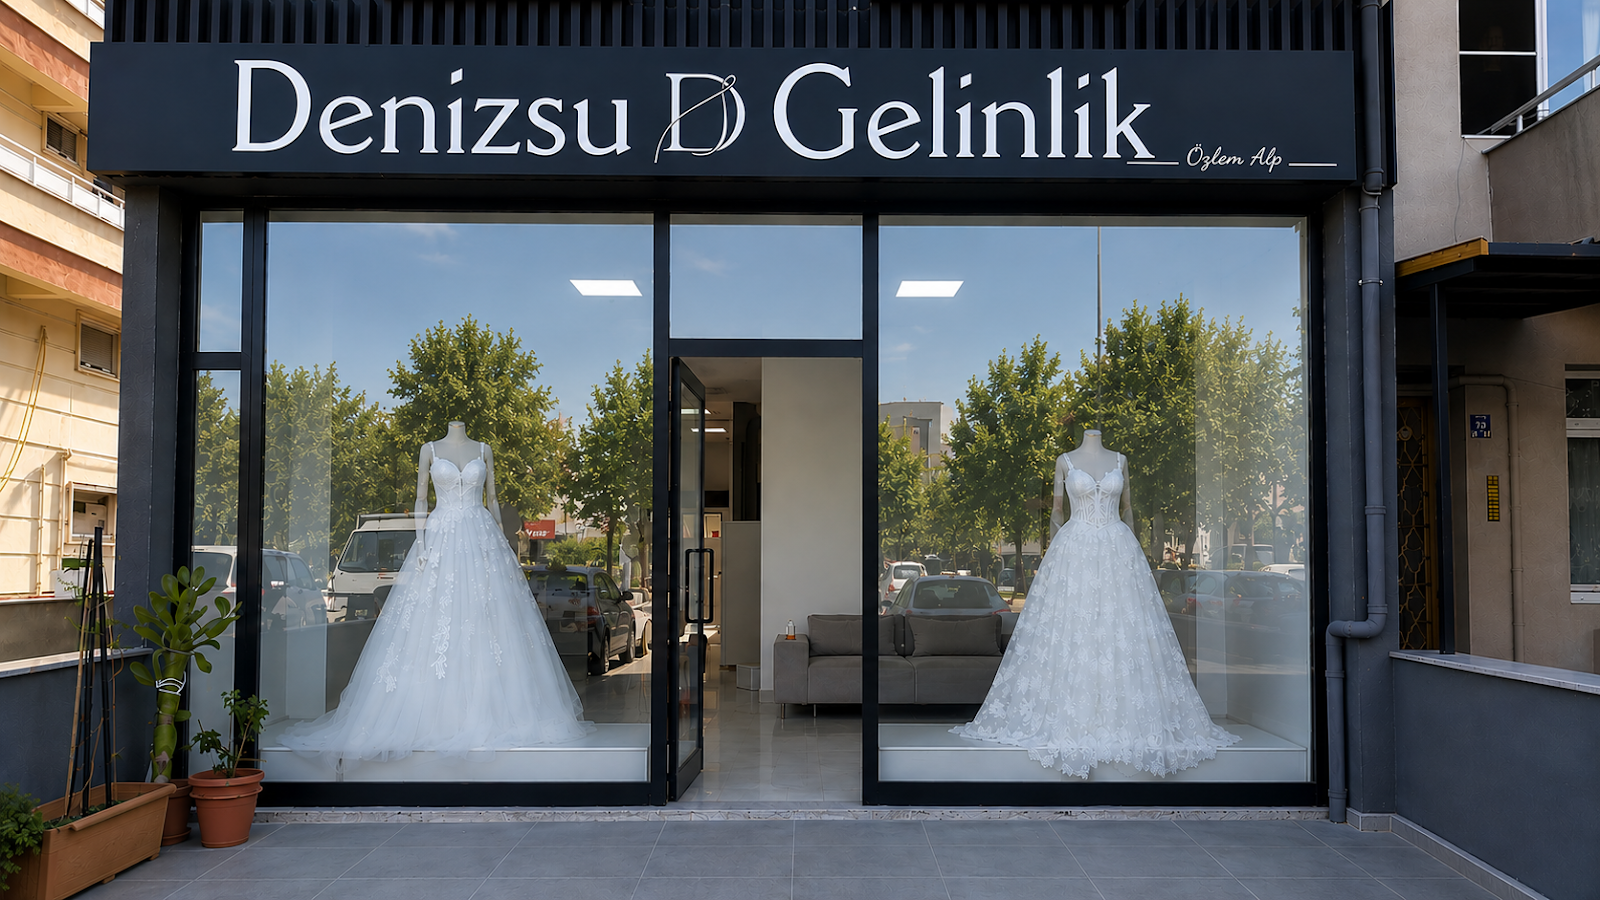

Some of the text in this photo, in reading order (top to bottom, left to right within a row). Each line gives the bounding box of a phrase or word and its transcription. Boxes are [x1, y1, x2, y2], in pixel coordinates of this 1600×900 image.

[232, 60, 632, 156] Denizsu
[773, 63, 1156, 160] Gelinlik
[1186, 143, 1283, 173] Özlem Alp
